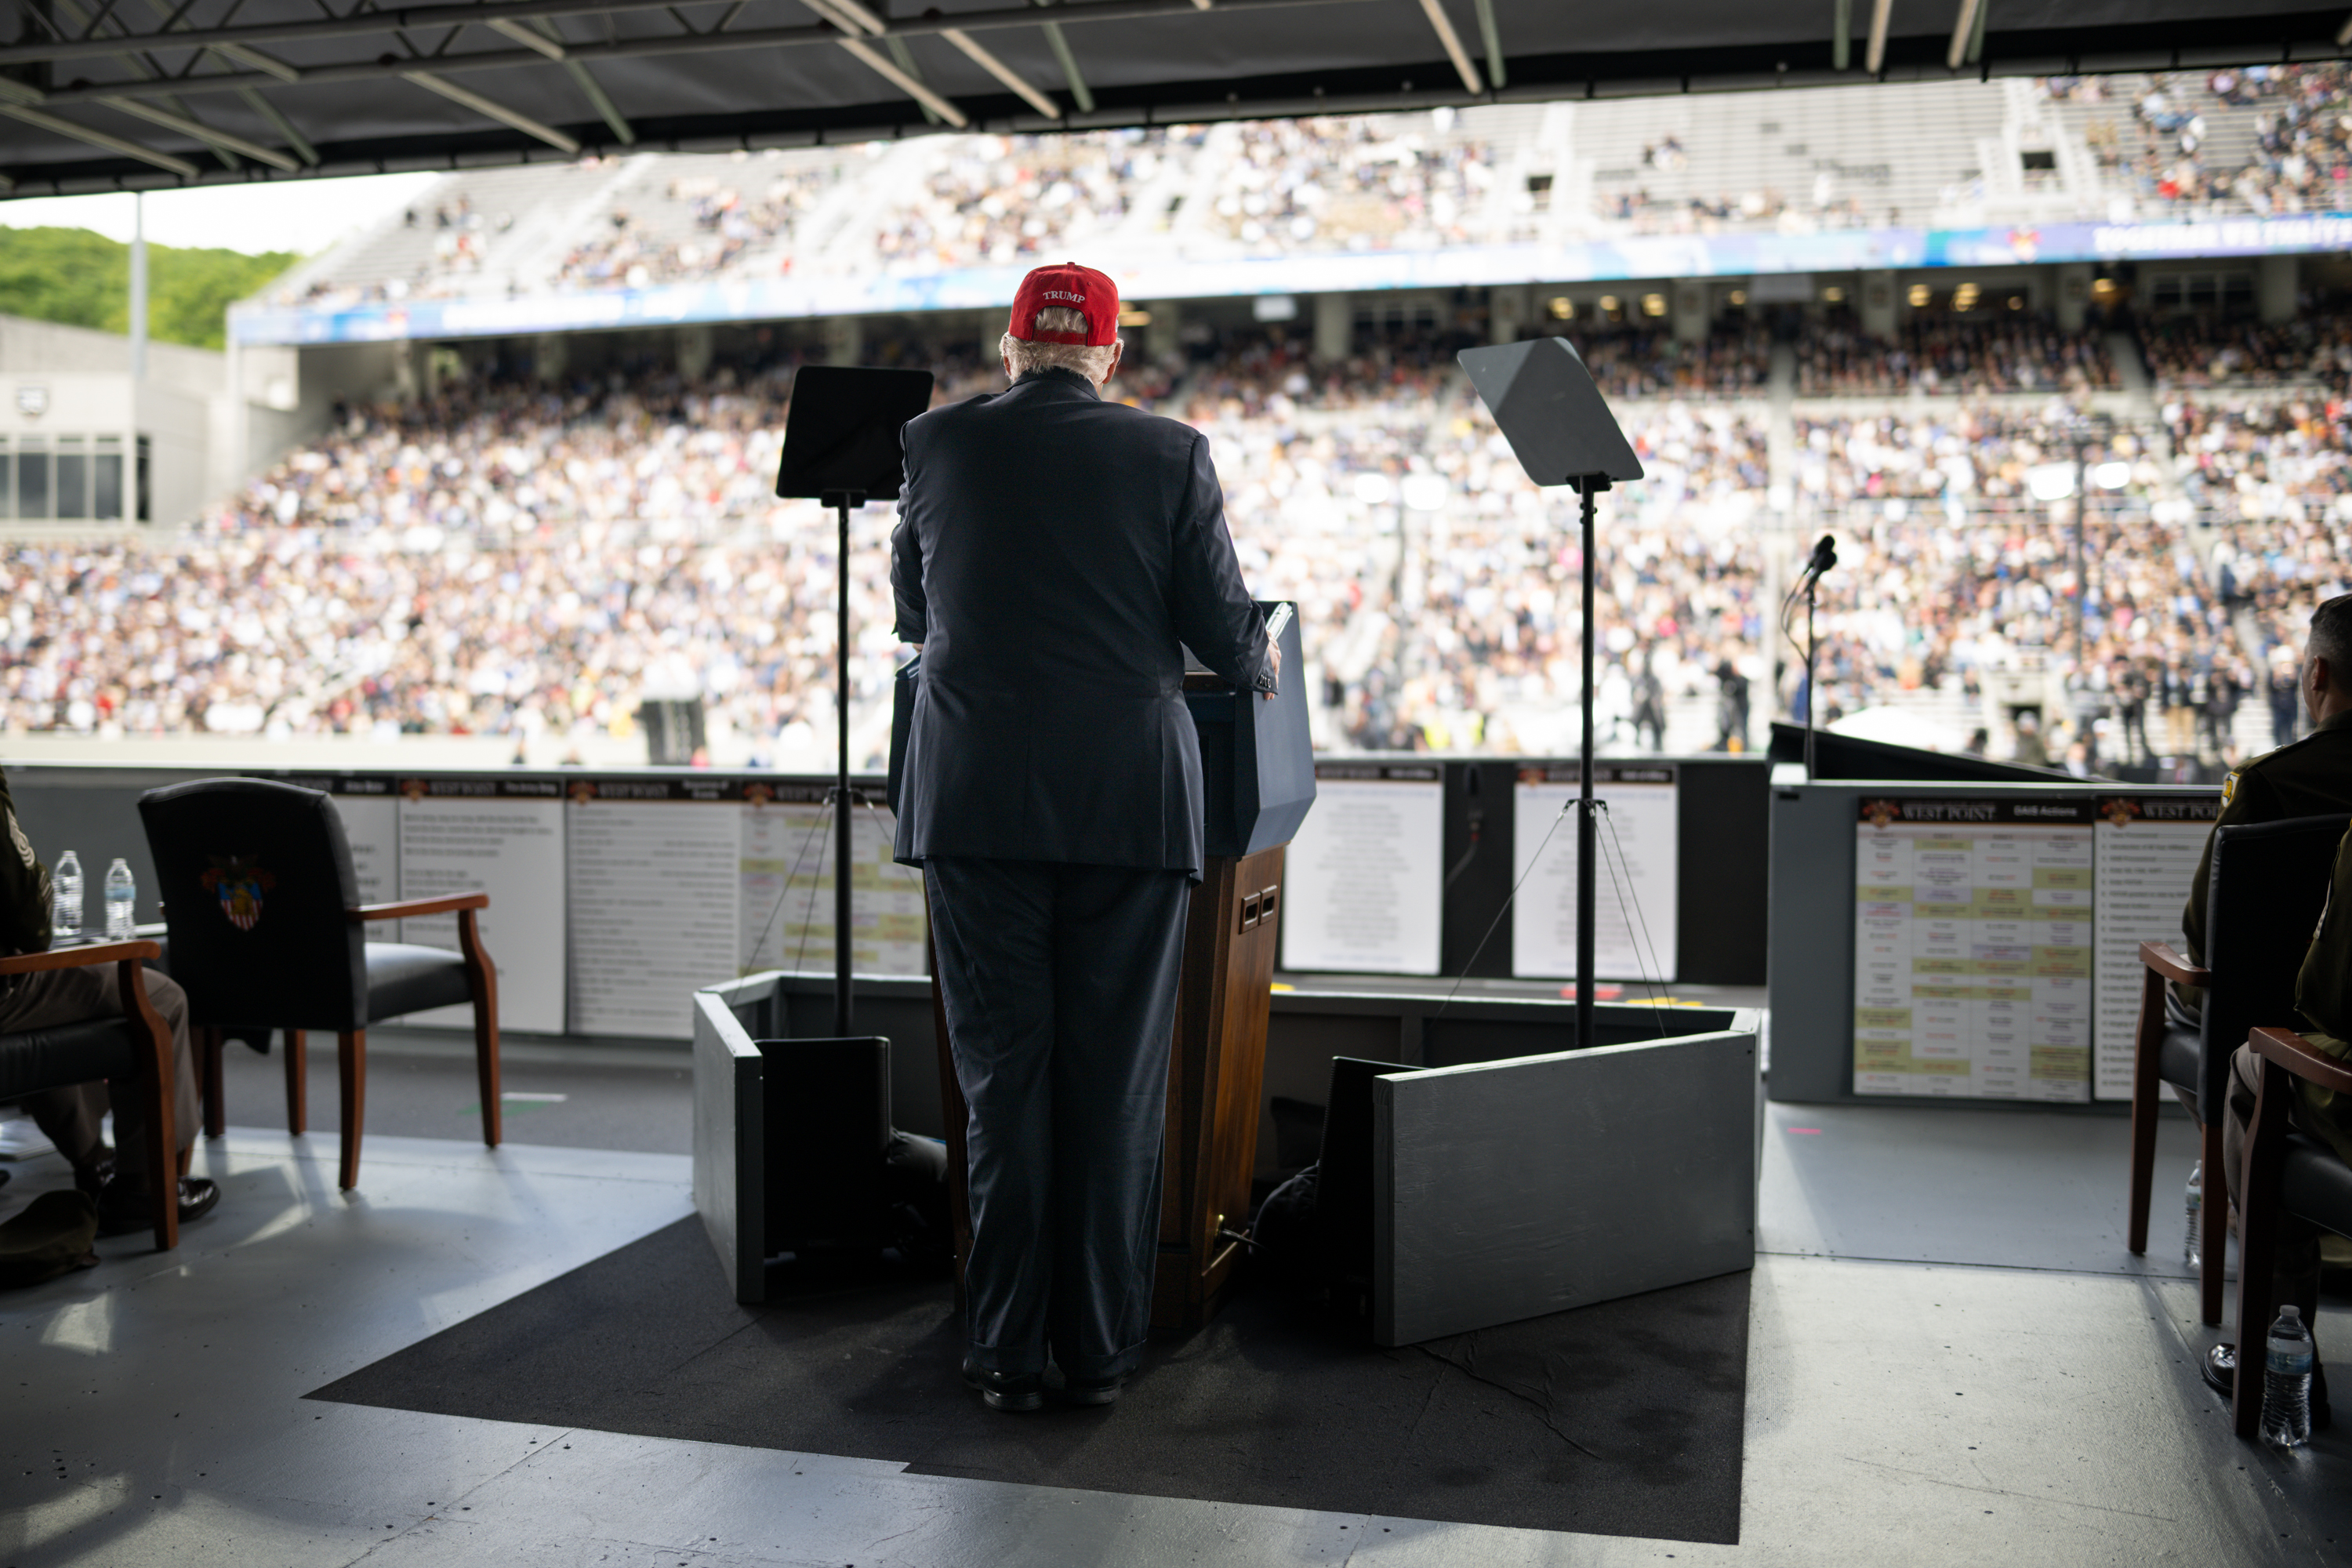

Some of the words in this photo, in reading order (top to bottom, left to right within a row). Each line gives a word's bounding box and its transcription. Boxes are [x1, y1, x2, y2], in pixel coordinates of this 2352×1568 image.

[1043, 290, 1086, 303] TRUMP
[1903, 805, 1943, 820] WEST
[1947, 805, 1997, 821] POINT
[2041, 805, 2078, 817] Actions
[2143, 804, 2187, 818] WEST
[2190, 804, 2219, 819] POI
